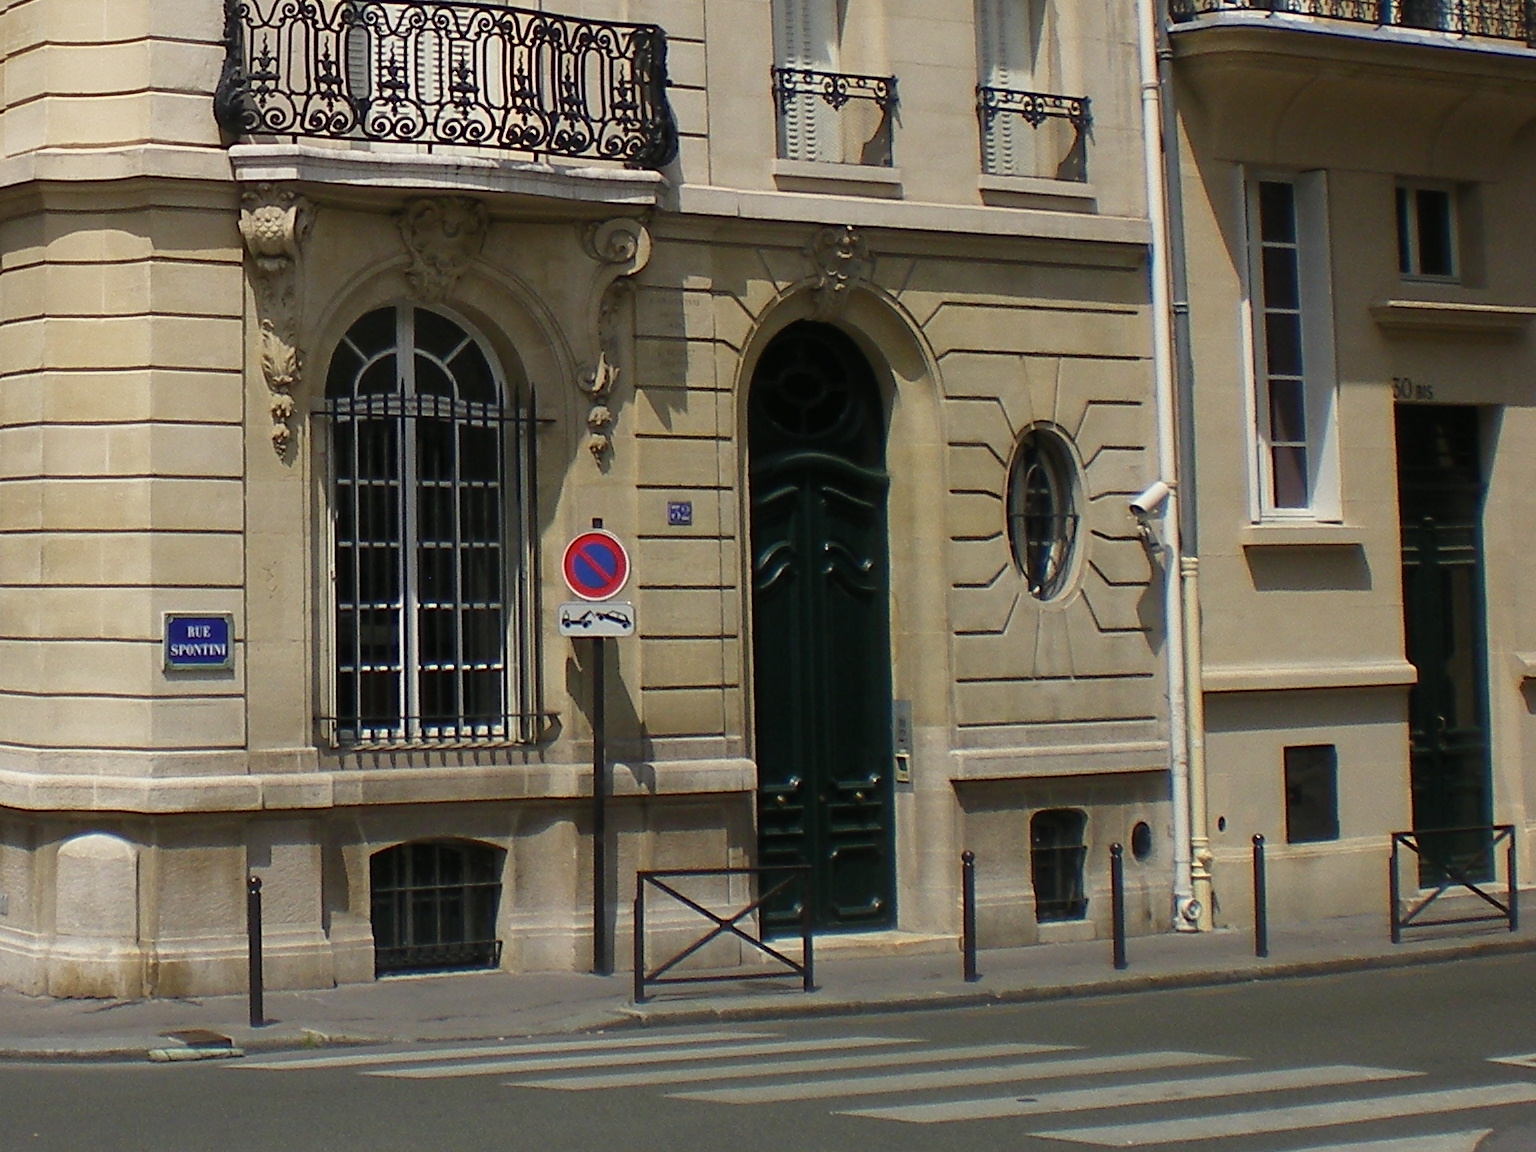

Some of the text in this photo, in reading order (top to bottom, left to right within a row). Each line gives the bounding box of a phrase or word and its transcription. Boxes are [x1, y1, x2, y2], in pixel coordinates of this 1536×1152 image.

[1393, 377, 1412, 398] 30
[187, 625, 211, 638] RUE
[170, 642, 226, 656] SPONTINI
